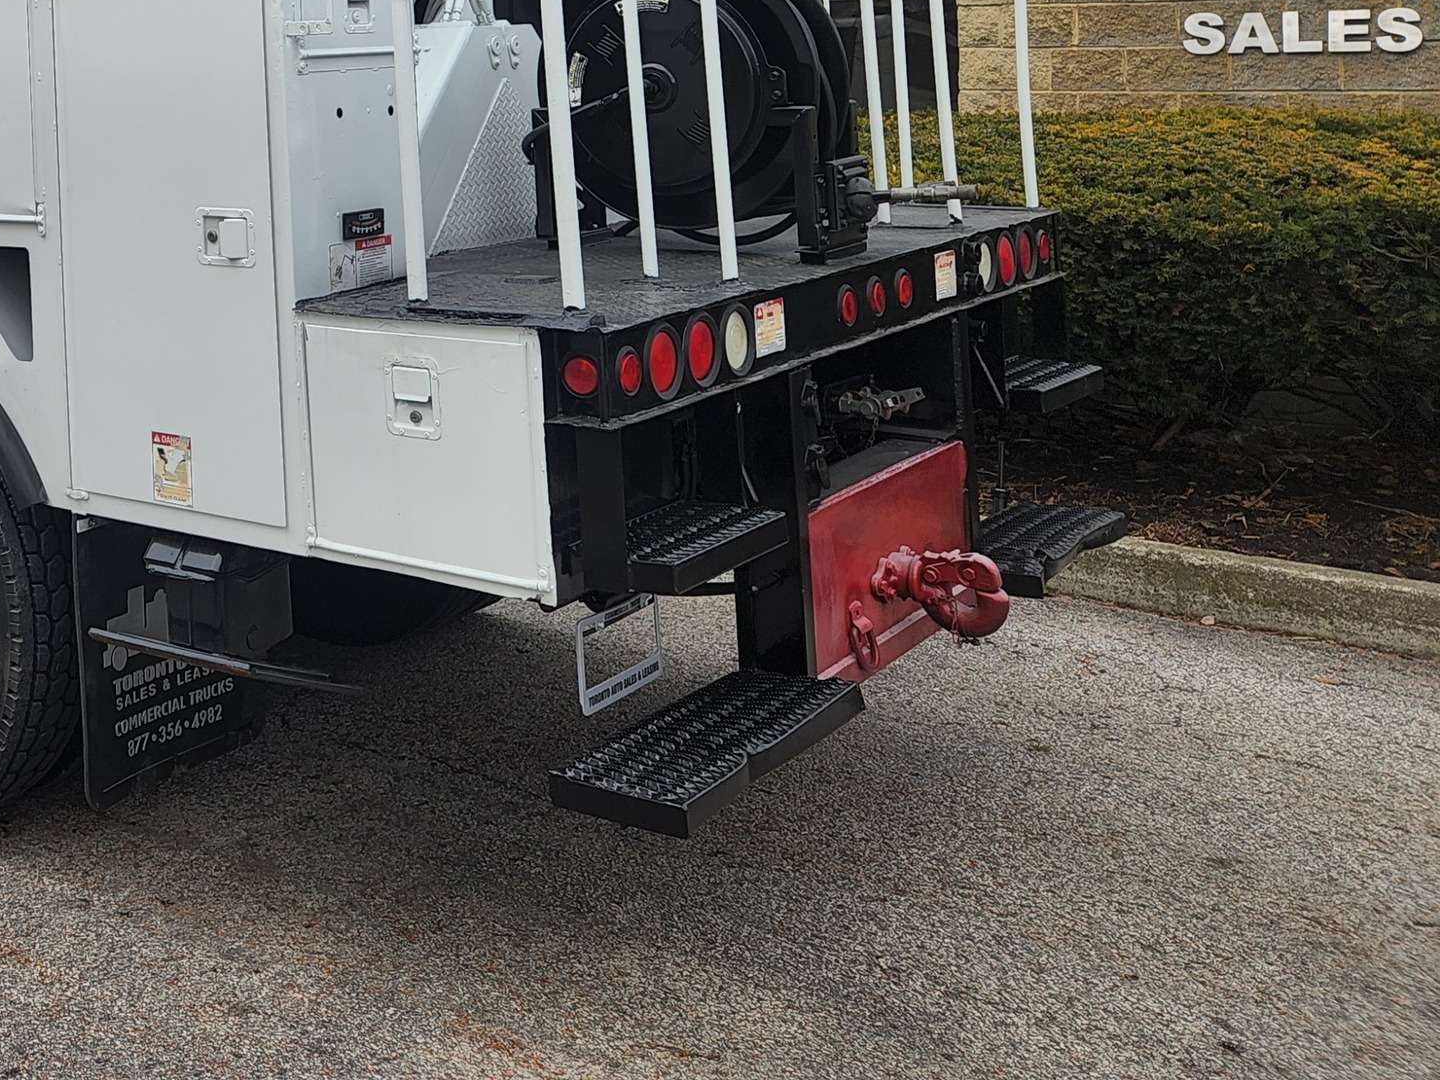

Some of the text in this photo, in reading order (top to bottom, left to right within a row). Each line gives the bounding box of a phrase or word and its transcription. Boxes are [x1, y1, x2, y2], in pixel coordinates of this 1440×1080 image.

[1182, 7, 1424, 55] SALES
[114, 677, 235, 737] COMMERCIAL TRUCKS
[115, 665, 215, 711] SALES & LEAS
